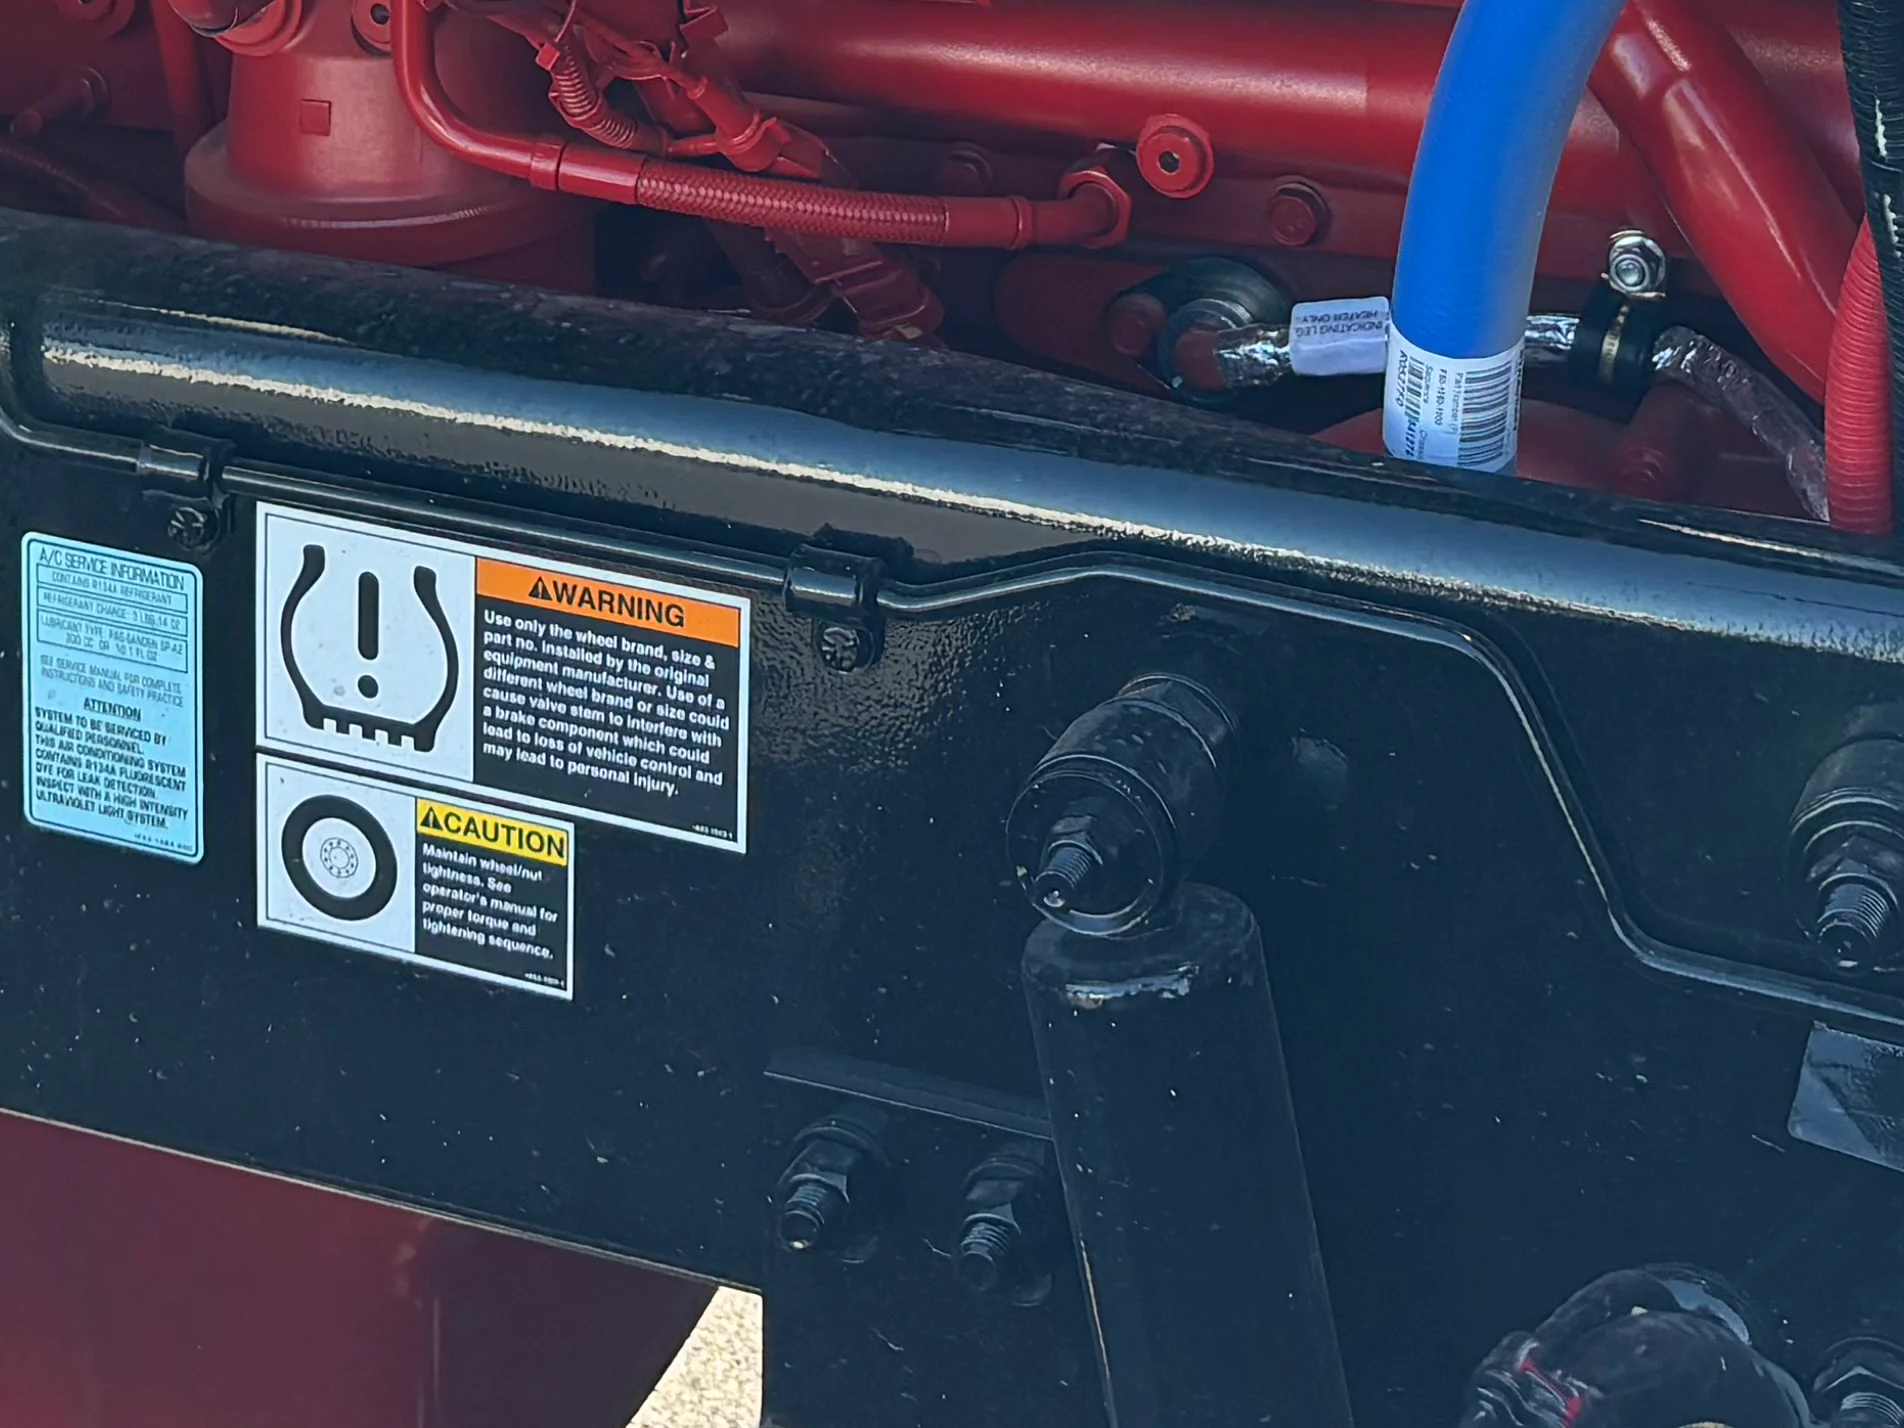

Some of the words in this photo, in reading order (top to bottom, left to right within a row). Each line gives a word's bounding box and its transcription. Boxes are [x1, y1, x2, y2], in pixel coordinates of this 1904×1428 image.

[1318, 320, 1384, 336] INDICATING
[1331, 309, 1379, 323] HEATER
[39, 547, 62, 566] A/C
[65, 554, 108, 575] SERVICE
[111, 563, 185, 591] INFORMATION
[553, 580, 684, 628] WARNING
[484, 609, 511, 628] Use
[515, 618, 546, 637] only
[549, 623, 572, 639] the
[576, 629, 617, 648] wheel
[622, 637, 668, 661] brand,
[672, 649, 700, 666] size
[704, 655, 716, 670] &
[484, 632, 512, 648] part
[516, 637, 538, 652] no.
[542, 640, 602, 665] installed
[606, 653, 624, 672] by
[628, 658, 649, 675] the
[654, 664, 709, 688] original
[484, 650, 559, 676] equipment
[562, 663, 662, 696] manufacturer.
[666, 685, 693, 705] Use
[697, 692, 713, 708] of
[716, 699, 725, 711] a
[484, 668, 543, 691] different
[546, 679, 588, 699] wheel
[592, 688, 633, 708] brand
[637, 699, 652, 712] or
[656, 702, 685, 721] size
[689, 710, 729, 731] could
[83, 697, 142, 722] ATTENTION
[484, 687, 525, 705] cause
[529, 695, 567, 714] valve
[570, 704, 605, 722] stem
[609, 712, 623, 726] to
[627, 713, 687, 740] interfere
[691, 729, 722, 748] with
[484, 705, 492, 718] a
[496, 705, 535, 725] brake
[538, 715, 618, 745] component
[622, 734, 665, 755] which
[669, 743, 710, 764] could
[484, 721, 513, 740] lead
[516, 730, 531, 744] to
[534, 732, 564, 751] loss
[568, 740, 583, 755] of
[586, 745, 637, 768] vehicle
[641, 757, 691, 779] control
[695, 766, 723, 786] and
[484, 742, 513, 762] may
[516, 748, 546, 767] lead
[549, 756, 564, 770] to
[568, 760, 629, 785] personal
[634, 769, 679, 797] injury.
[444, 811, 565, 859] CAUTION
[422, 843, 477, 868] Maintain
[480, 856, 544, 882] wheel/nut
[422, 862, 485, 888] tightness.
[487, 876, 512, 894] See
[422, 882, 488, 906] operator's
[490, 898, 537, 918] manual
[540, 907, 559, 923] for
[422, 900, 464, 922] proper
[467, 909, 510, 930] torque
[512, 920, 537, 937] and
[422, 918, 486, 946] tightening
[488, 936, 554, 960] sequence.
